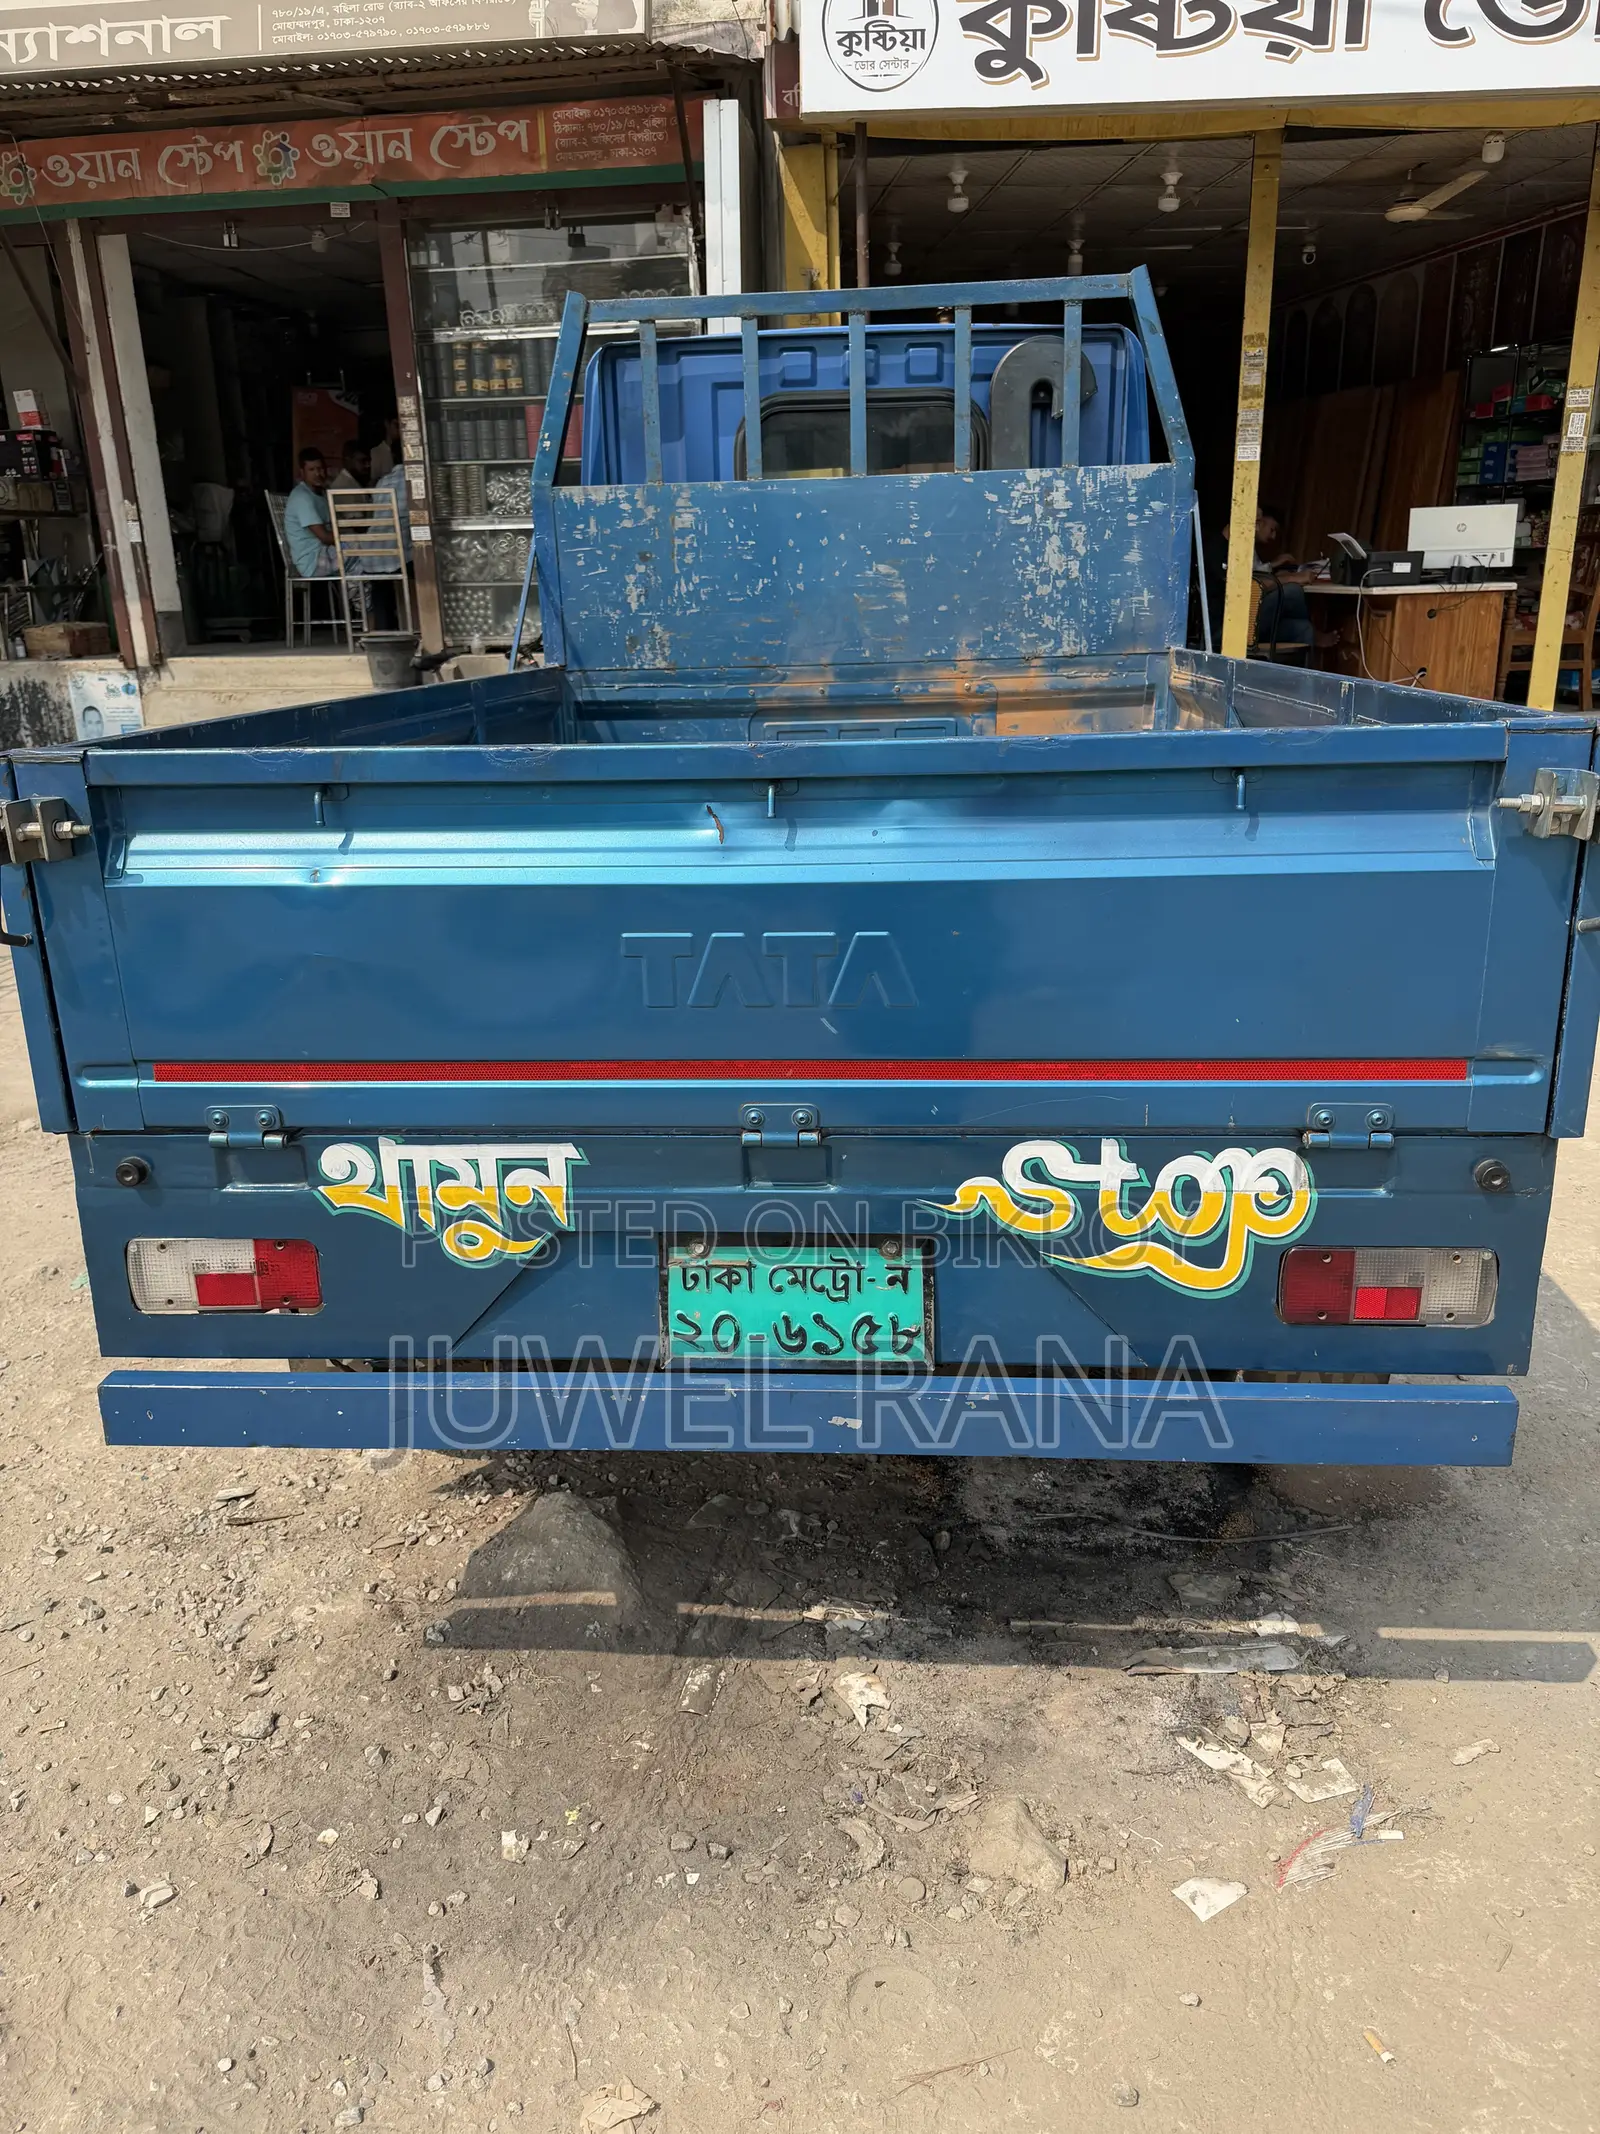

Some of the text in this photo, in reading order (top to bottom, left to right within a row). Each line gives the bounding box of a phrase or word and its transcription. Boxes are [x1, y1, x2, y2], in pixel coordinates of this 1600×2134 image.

[333, 16, 386, 27] ঢাকা-১২০৭
[363, 1, 385, 12] রোড
[835, 20, 926, 57] কুষ্টিয়া
[854, 57, 910, 71] ডোর সেন্টার
[305, 115, 531, 170] ওয়ান স্টেপ
[41, 135, 244, 190] ওয়ান স্টেপ
[620, 931, 920, 1008] TATA
[313, 1135, 590, 1268] থামুন
[678, 1259, 757, 1294] ঢাকা
